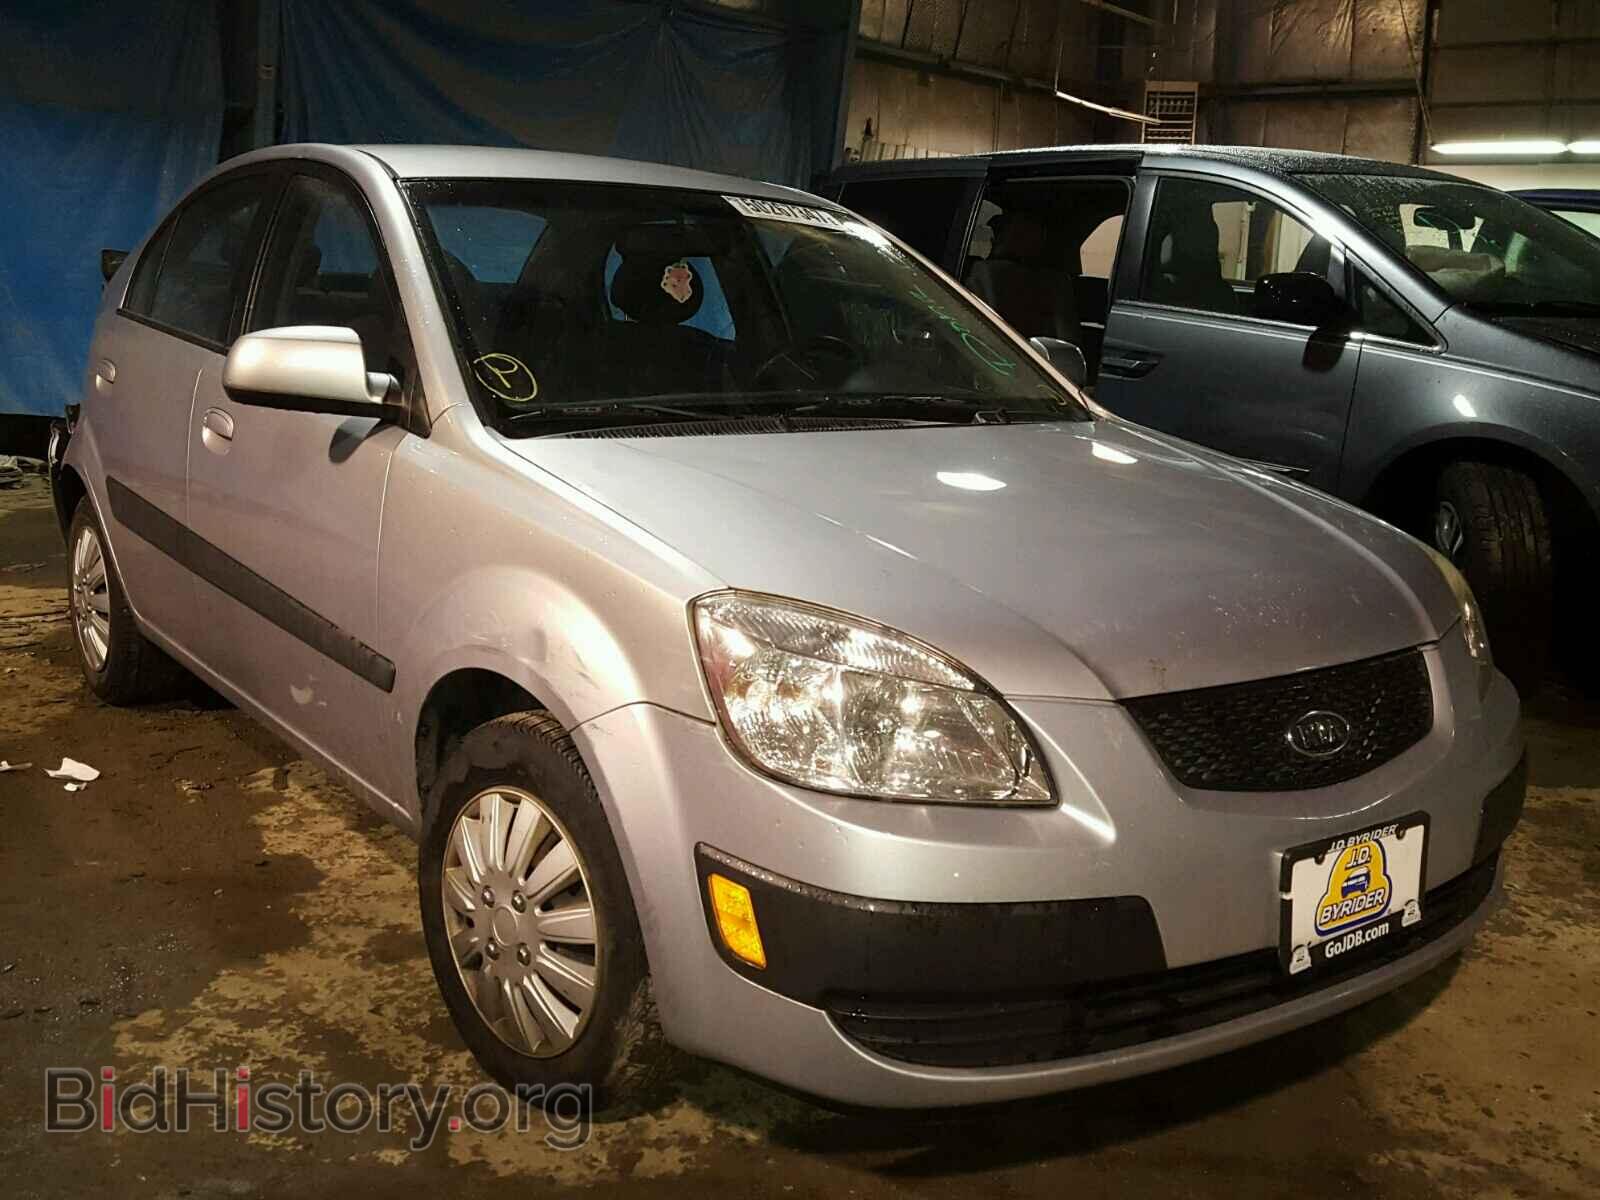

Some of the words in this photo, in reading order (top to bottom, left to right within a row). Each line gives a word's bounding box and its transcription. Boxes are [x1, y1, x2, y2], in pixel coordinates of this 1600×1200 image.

[1348, 823, 1399, 846] BYRIDER
[1345, 846, 1372, 869] J.D.
[1320, 889, 1386, 924] BYRIDER
[1325, 922, 1390, 959] GoJDB.com
